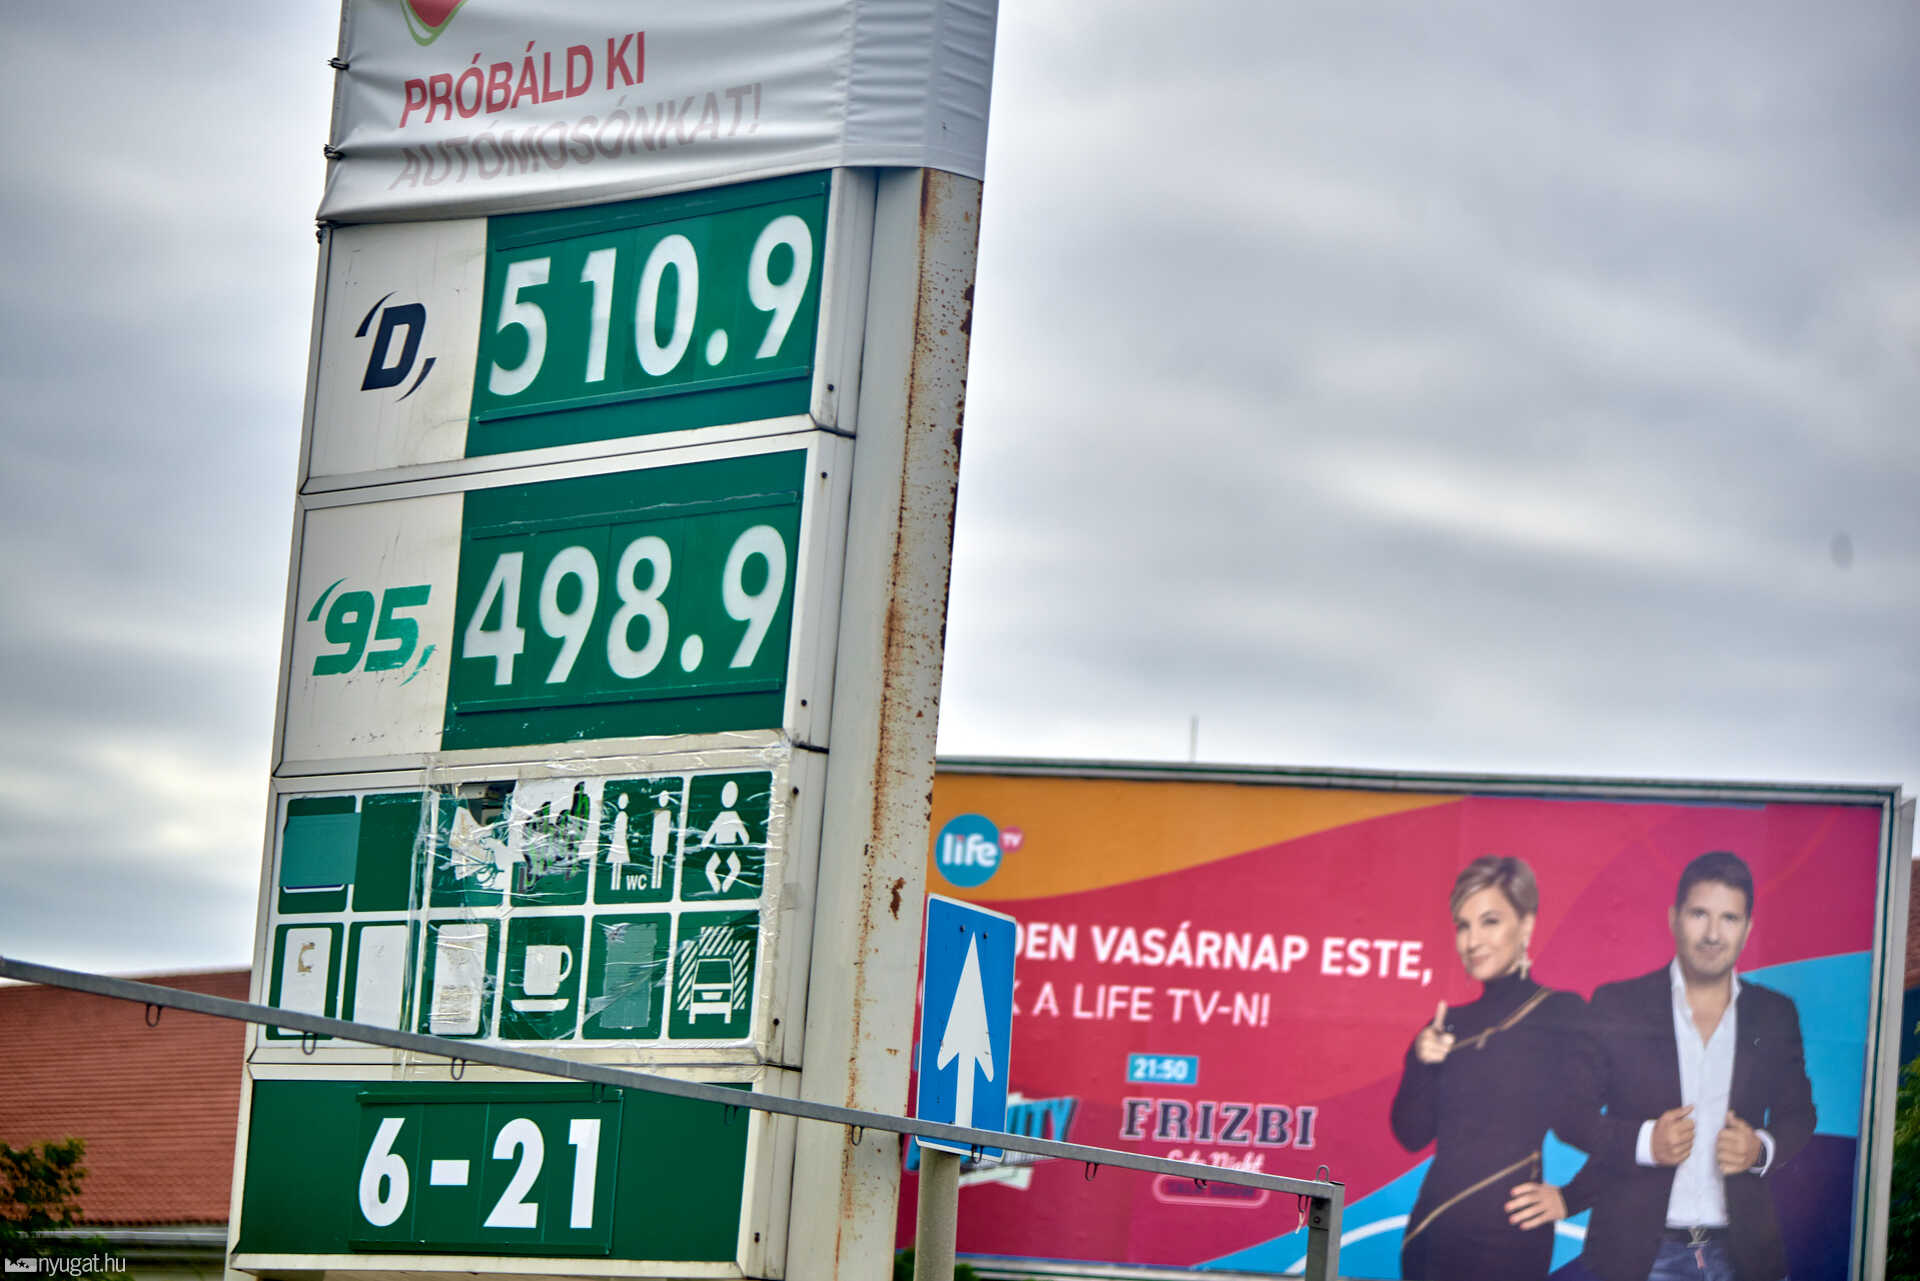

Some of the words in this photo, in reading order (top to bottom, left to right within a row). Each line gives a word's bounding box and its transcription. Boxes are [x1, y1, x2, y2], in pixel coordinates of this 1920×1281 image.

[399, 41, 594, 129] PRÓBÁLD
[606, 31, 645, 90] KI
[487, 214, 814, 397] 510.9
[462, 524, 788, 687] 498.9
[943, 833, 999, 868] life
[626, 874, 648, 891] WC
[1091, 920, 1309, 973] VASÁRNAP
[1320, 936, 1433, 987] ESTE,
[1031, 980, 1060, 1018] A
[1072, 983, 1156, 1022] LIFE
[1166, 987, 1271, 1028] TV-N!
[1133, 1058, 1189, 1081] 21:50
[1119, 1096, 1319, 1150] FRIZBI
